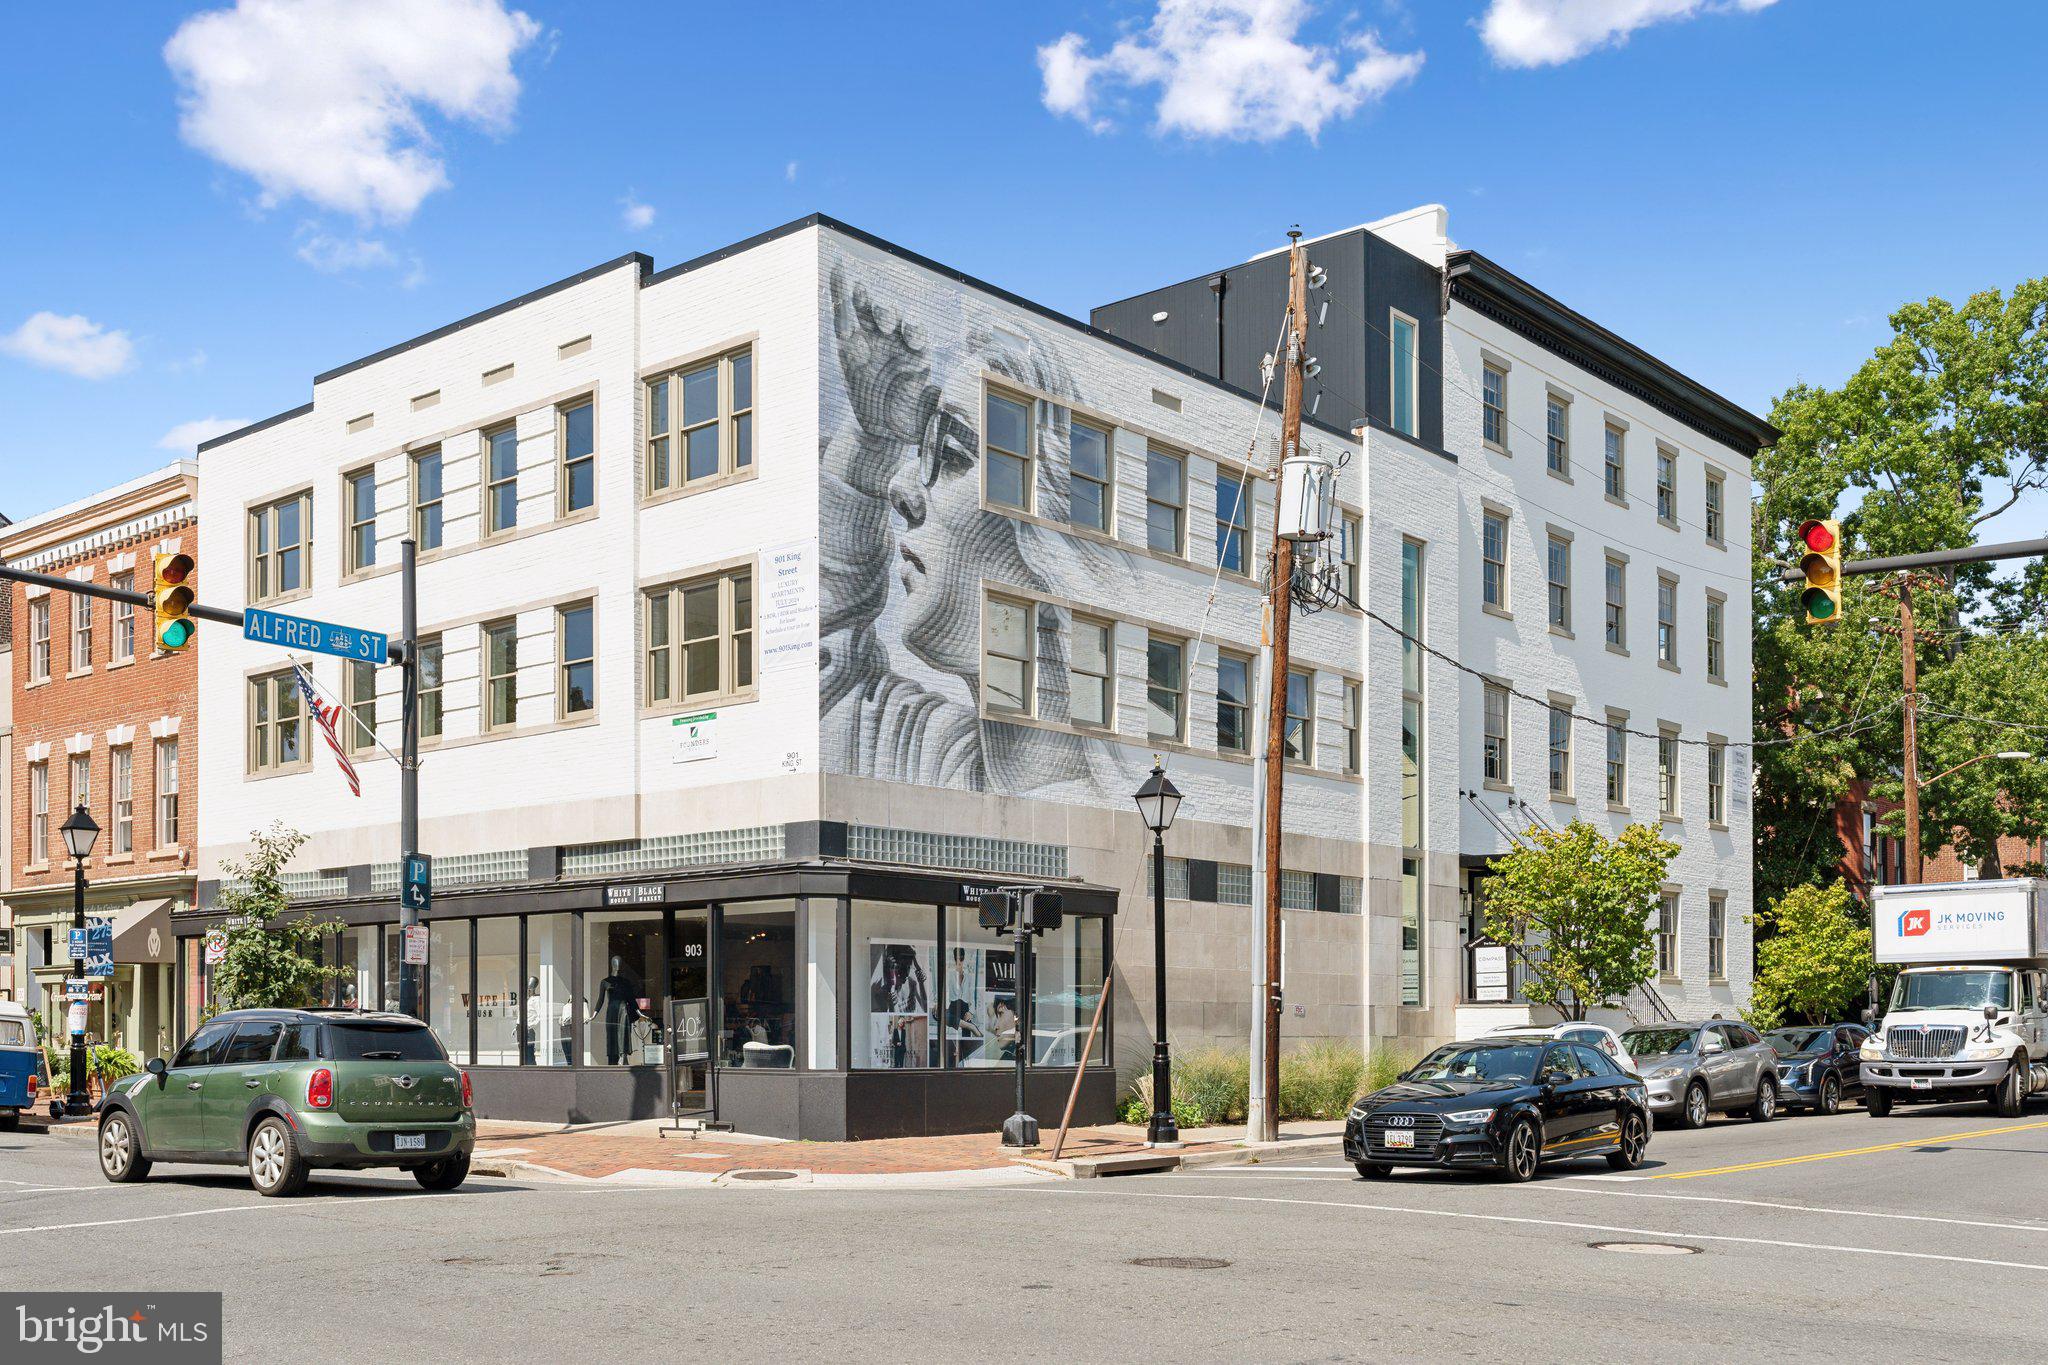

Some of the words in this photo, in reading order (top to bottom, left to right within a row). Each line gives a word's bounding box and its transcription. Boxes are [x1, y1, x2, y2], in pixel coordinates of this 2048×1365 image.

[774, 555, 785, 564] 901
[786, 552, 802, 562] King
[778, 566, 798, 576] Street
[249, 614, 320, 648] ALFRED
[359, 634, 381, 658] ST
[680, 739, 710, 749] FOUNDERS
[787, 752, 798, 760] 901
[782, 760, 794, 768] KING
[413, 862, 424, 880] P
[86, 917, 112, 930] ALX
[1908, 916, 1924, 930] JK
[1938, 914, 1952, 924] JK
[1956, 912, 2004, 922] MOVING
[92, 926, 113, 940] 275
[685, 944, 702, 957] 903
[85, 952, 113, 970] ALX
[461, 993, 498, 1007] WITE
